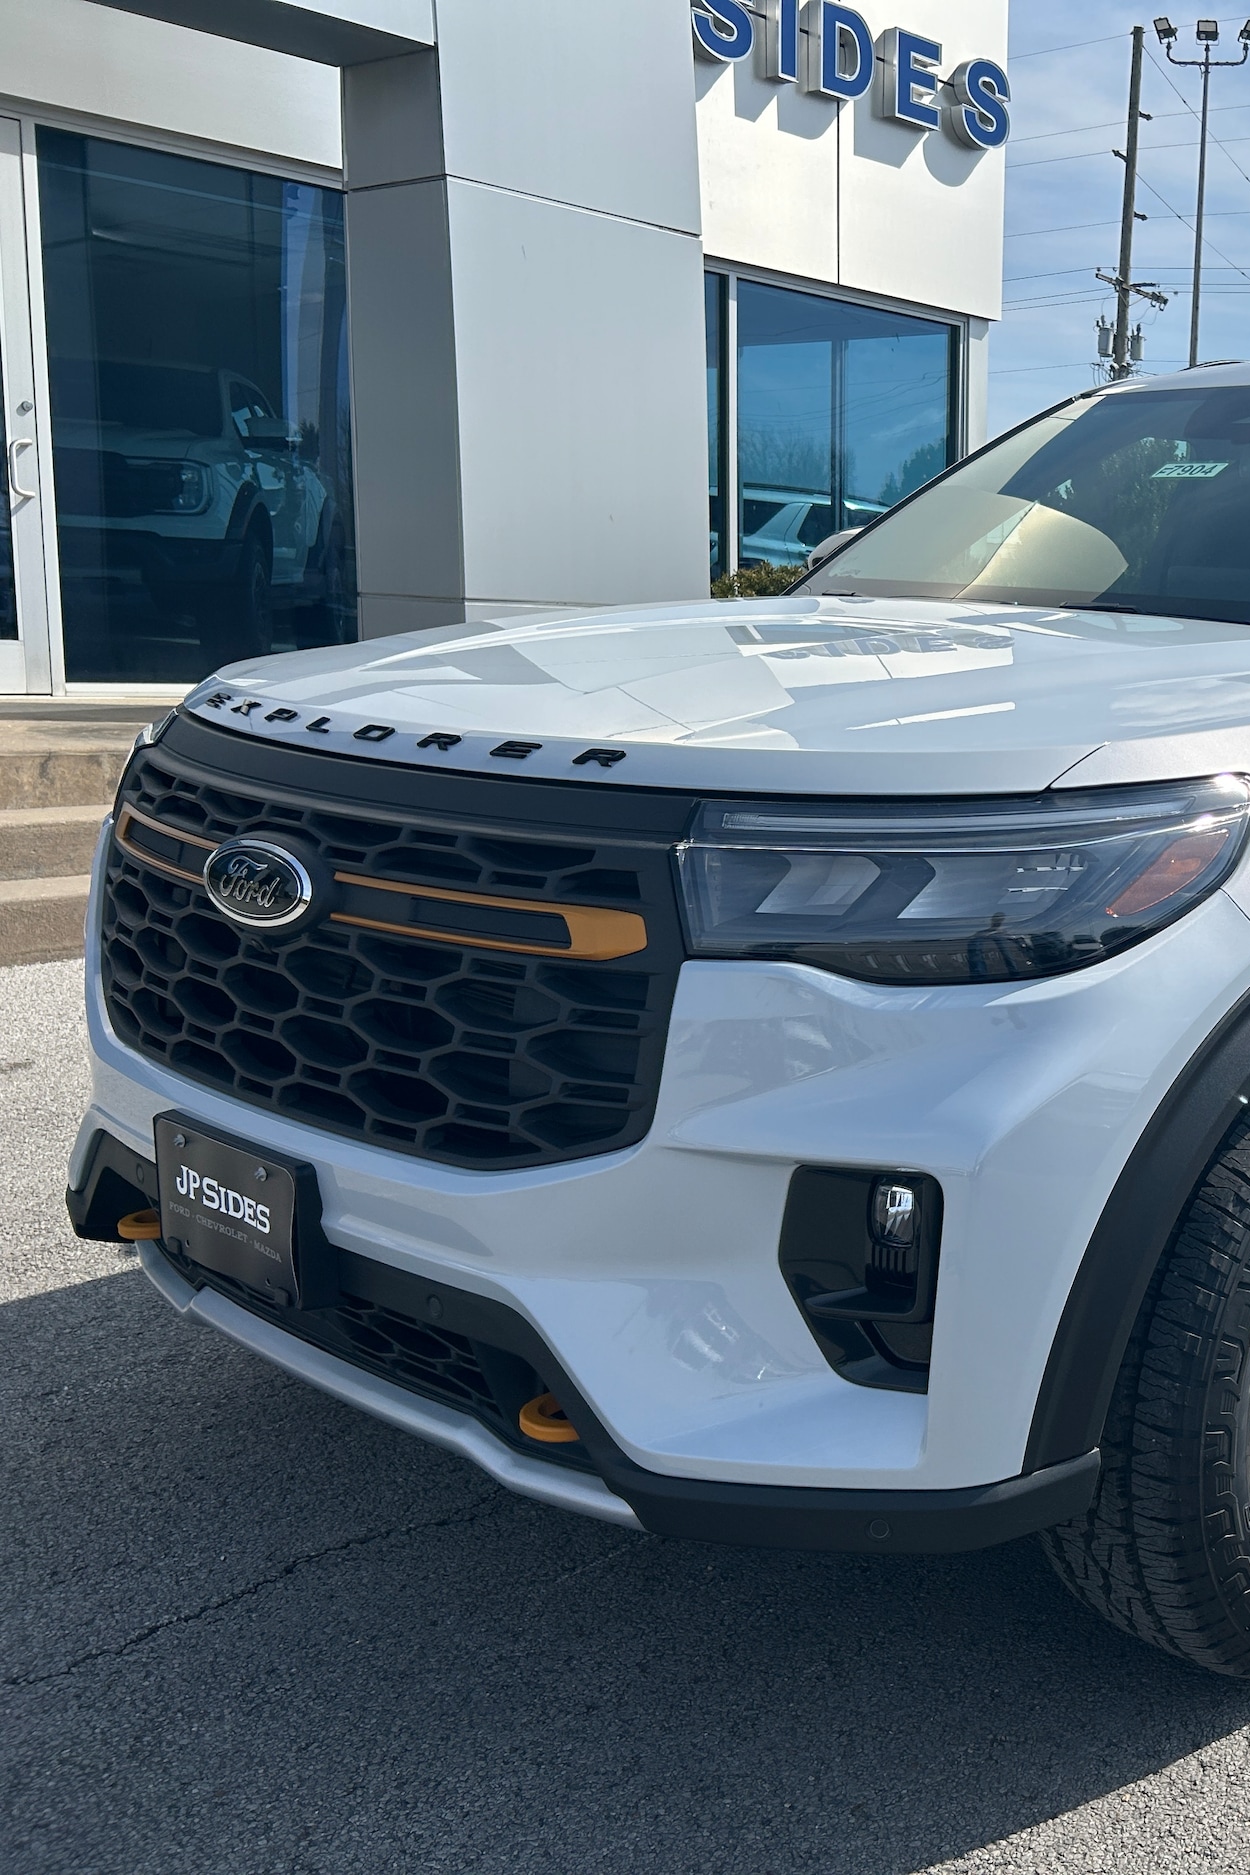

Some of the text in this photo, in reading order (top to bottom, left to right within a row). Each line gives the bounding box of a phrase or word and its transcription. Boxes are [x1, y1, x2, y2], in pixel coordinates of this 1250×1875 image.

[205, 692, 627, 768] EXPLORER
[219, 855, 281, 908] Ford
[169, 1201, 282, 1263] FORD CHEVROLET MAZDA
[175, 1164, 271, 1234] JP SIDES
